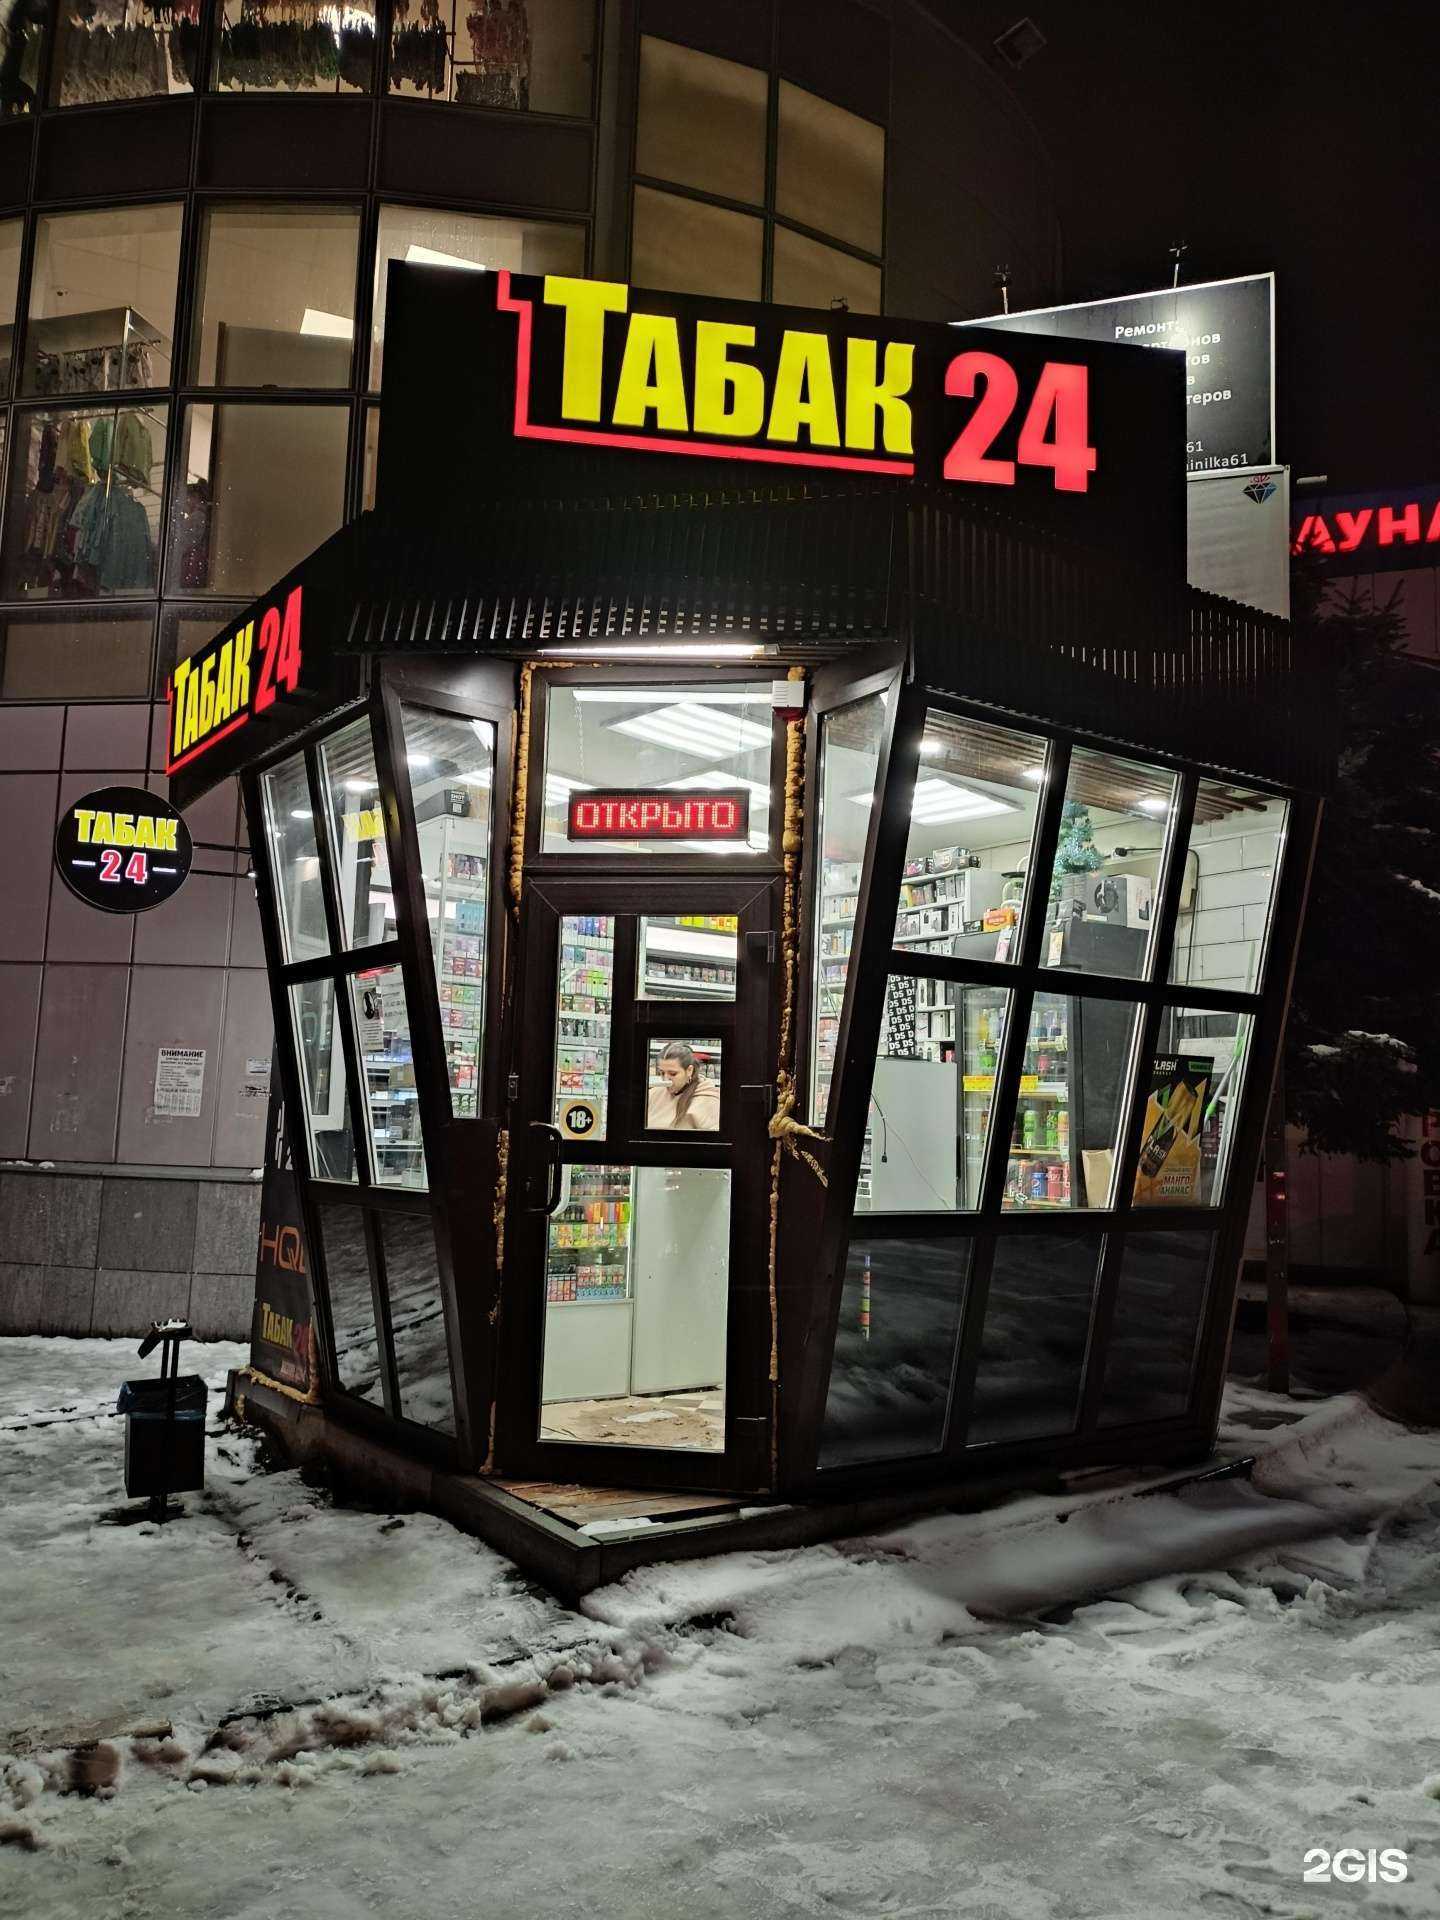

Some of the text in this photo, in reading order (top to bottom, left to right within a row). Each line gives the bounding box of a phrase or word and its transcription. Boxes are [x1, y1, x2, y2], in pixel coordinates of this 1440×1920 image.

[544, 275, 1096, 492] ТАБАК 24
[1186, 453, 1248, 471] inilka61
[173, 585, 303, 757] ТАБАК 24
[74, 809, 178, 851] ТАБАК
[576, 801, 735, 829] ОТКРЫТО
[100, 849, 147, 885] 24
[161, 1049, 204, 1058] ВНИМАНИЕ
[569, 1110, 592, 1128] 18+
[262, 1302, 294, 1349] ТАБАК
